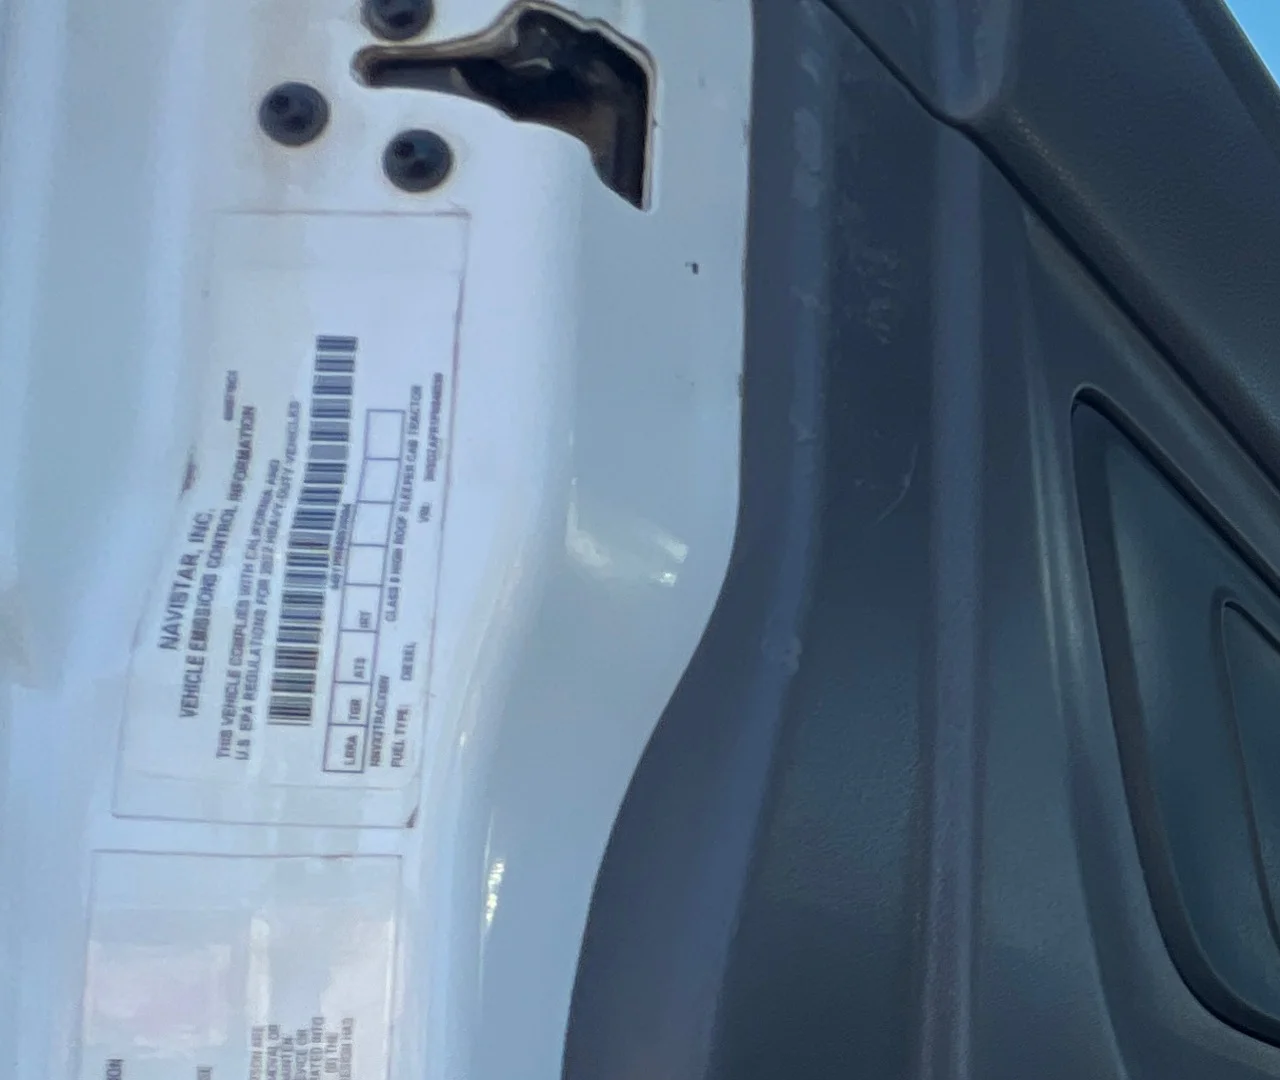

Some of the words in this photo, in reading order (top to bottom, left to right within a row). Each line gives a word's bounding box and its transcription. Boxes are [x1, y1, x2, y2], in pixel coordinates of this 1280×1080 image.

[280, 400, 300, 463] VEHICLES
[406, 384, 423, 436] TRACTOR
[226, 405, 257, 502] INFORMATION
[398, 464, 414, 513] SLEEPER
[205, 507, 238, 569] CONTROL
[244, 490, 273, 560] CALIFORNIA
[392, 515, 408, 545] ROOF
[156, 549, 204, 651] NAVISTAR,
[187, 509, 215, 544] INC.
[238, 563, 253, 596] WITH
[390, 547, 403, 574] HIGH
[188, 574, 216, 652] EMISSIONS
[255, 578, 268, 605] FOR
[383, 586, 400, 622] CLASS
[228, 600, 250, 666] COMPLIES
[242, 609, 267, 701] REGULATIONS
[178, 654, 205, 718] VEHICLE
[220, 670, 241, 726] VEHICLE
[390, 740, 408, 768] FUEL
[399, 642, 417, 682] DIESEL
[216, 730, 232, 759] THIS
[238, 706, 253, 732] EPA
